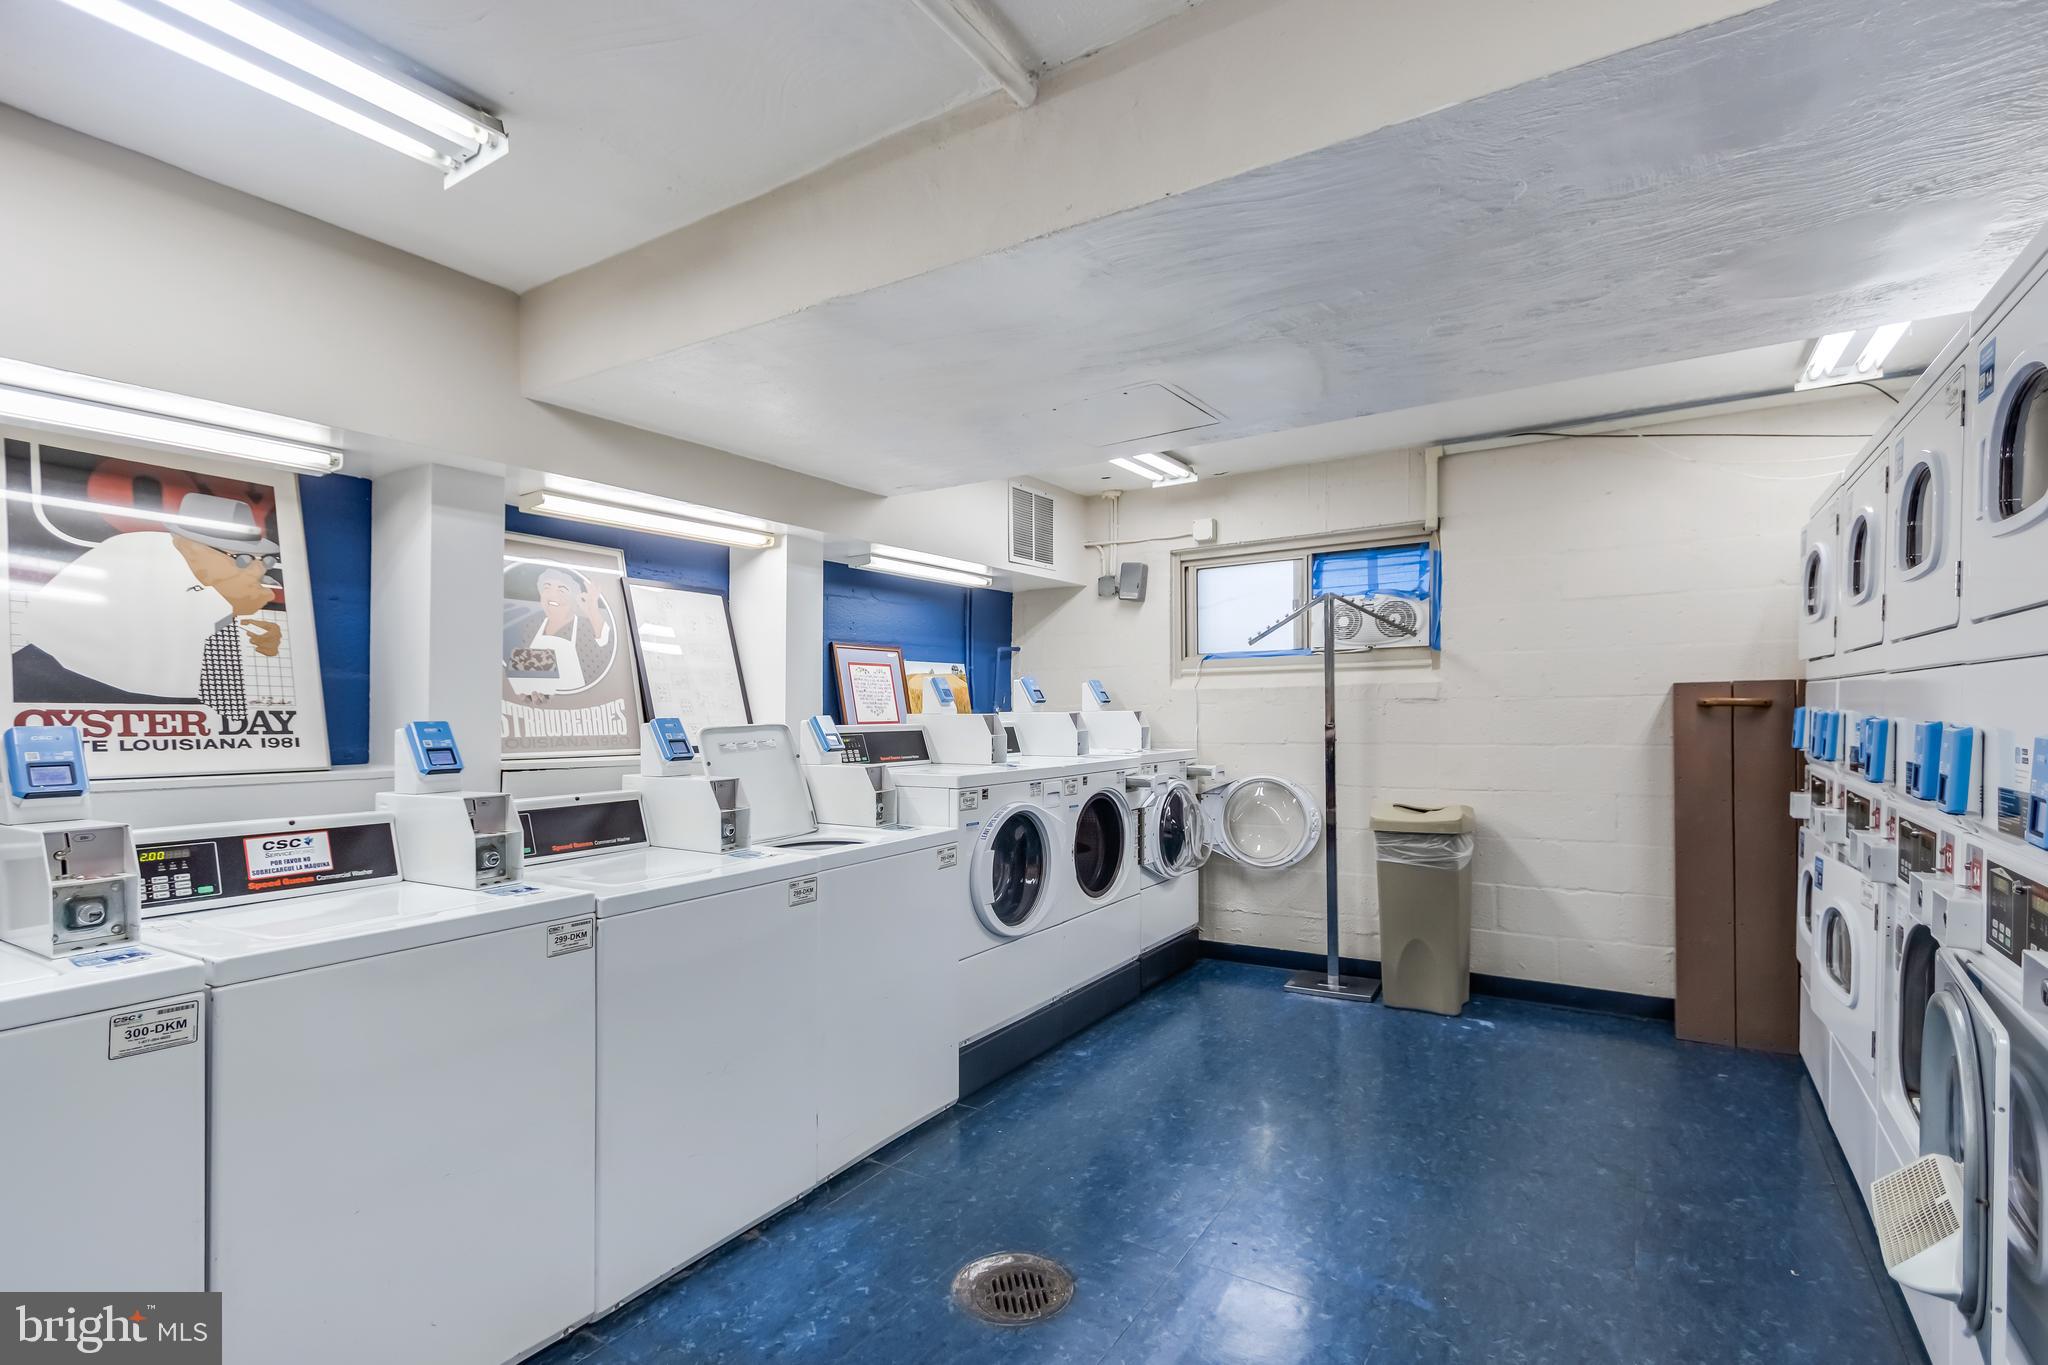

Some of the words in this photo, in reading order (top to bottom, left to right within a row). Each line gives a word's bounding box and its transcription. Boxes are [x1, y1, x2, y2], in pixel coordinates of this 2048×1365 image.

[14, 709, 211, 737] OYSTER
[219, 710, 297, 736] DAY
[119, 738, 252, 752] LOUISIANA
[261, 737, 300, 749] 1981
[504, 737, 592, 749] OUISIANA
[262, 838, 302, 851] CSC
[140, 851, 165, 862] 2.00
[283, 857, 302, 865] FAVOR
[248, 879, 281, 890] Speed
[124, 1019, 188, 1040] 300-DKM
